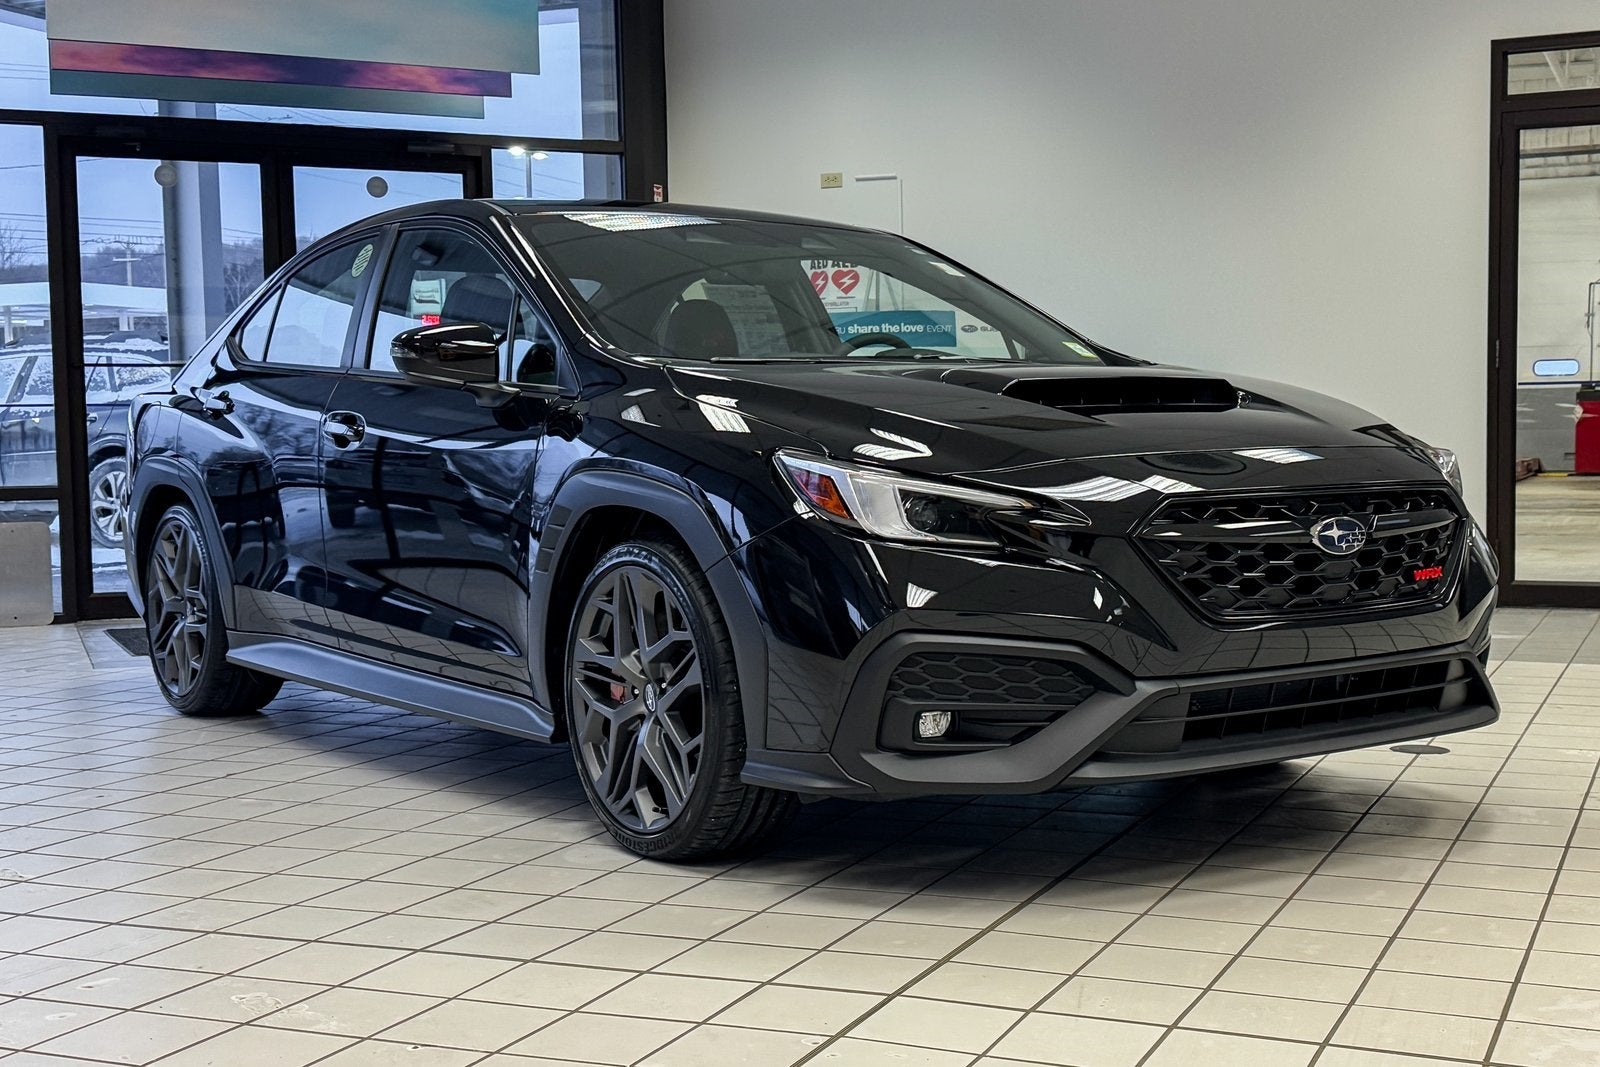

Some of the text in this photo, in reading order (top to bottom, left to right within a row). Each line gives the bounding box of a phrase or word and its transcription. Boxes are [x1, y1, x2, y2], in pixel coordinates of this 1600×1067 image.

[848, 323, 880, 334] share
[881, 323, 900, 333] the
[901, 322, 924, 333] love
[927, 325, 952, 333] EVENT
[1413, 566, 1443, 581] WRX
